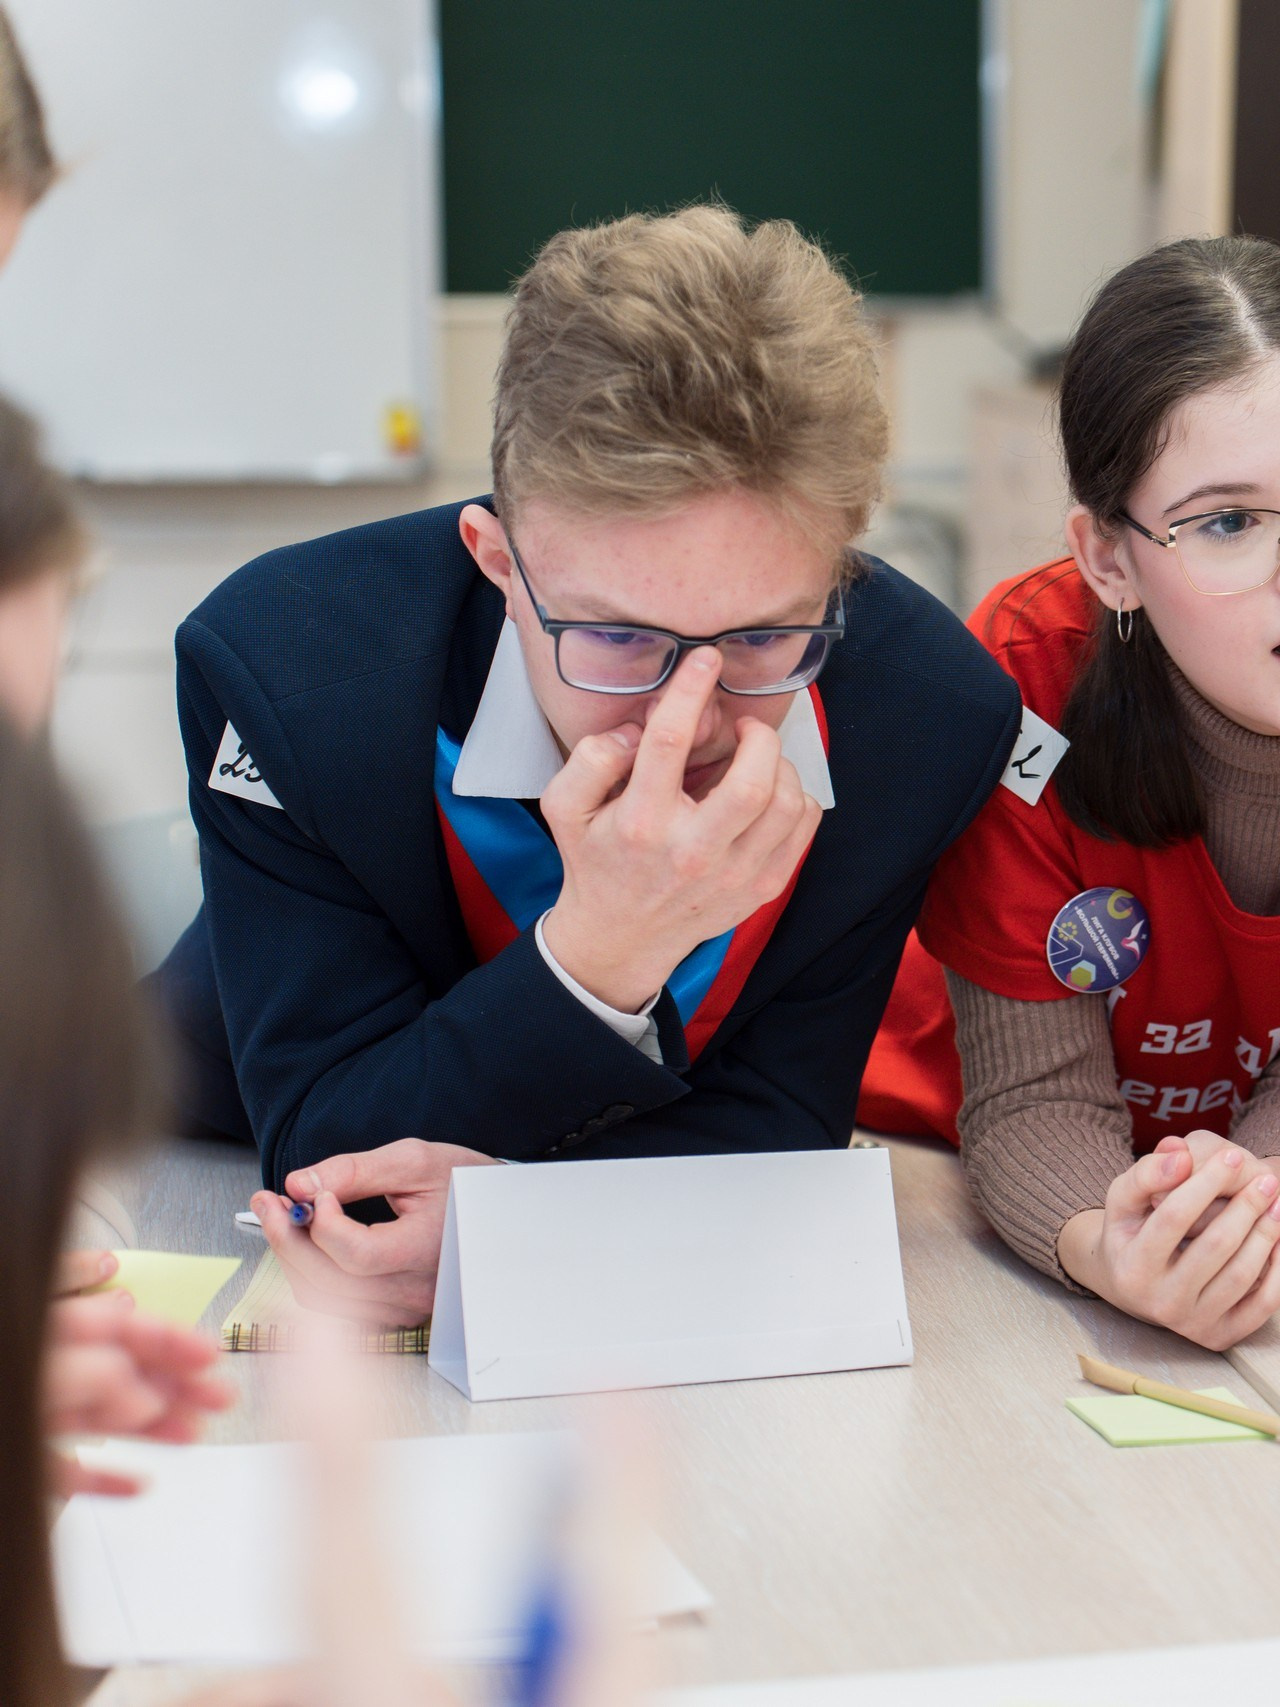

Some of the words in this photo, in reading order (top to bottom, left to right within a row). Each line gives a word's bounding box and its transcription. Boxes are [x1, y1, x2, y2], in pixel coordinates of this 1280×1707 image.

[1091, 916, 1104, 935] ЛИГА
[1100, 933, 1120, 960] КЛУБОВ
[1117, 1079, 1244, 1121] ере
